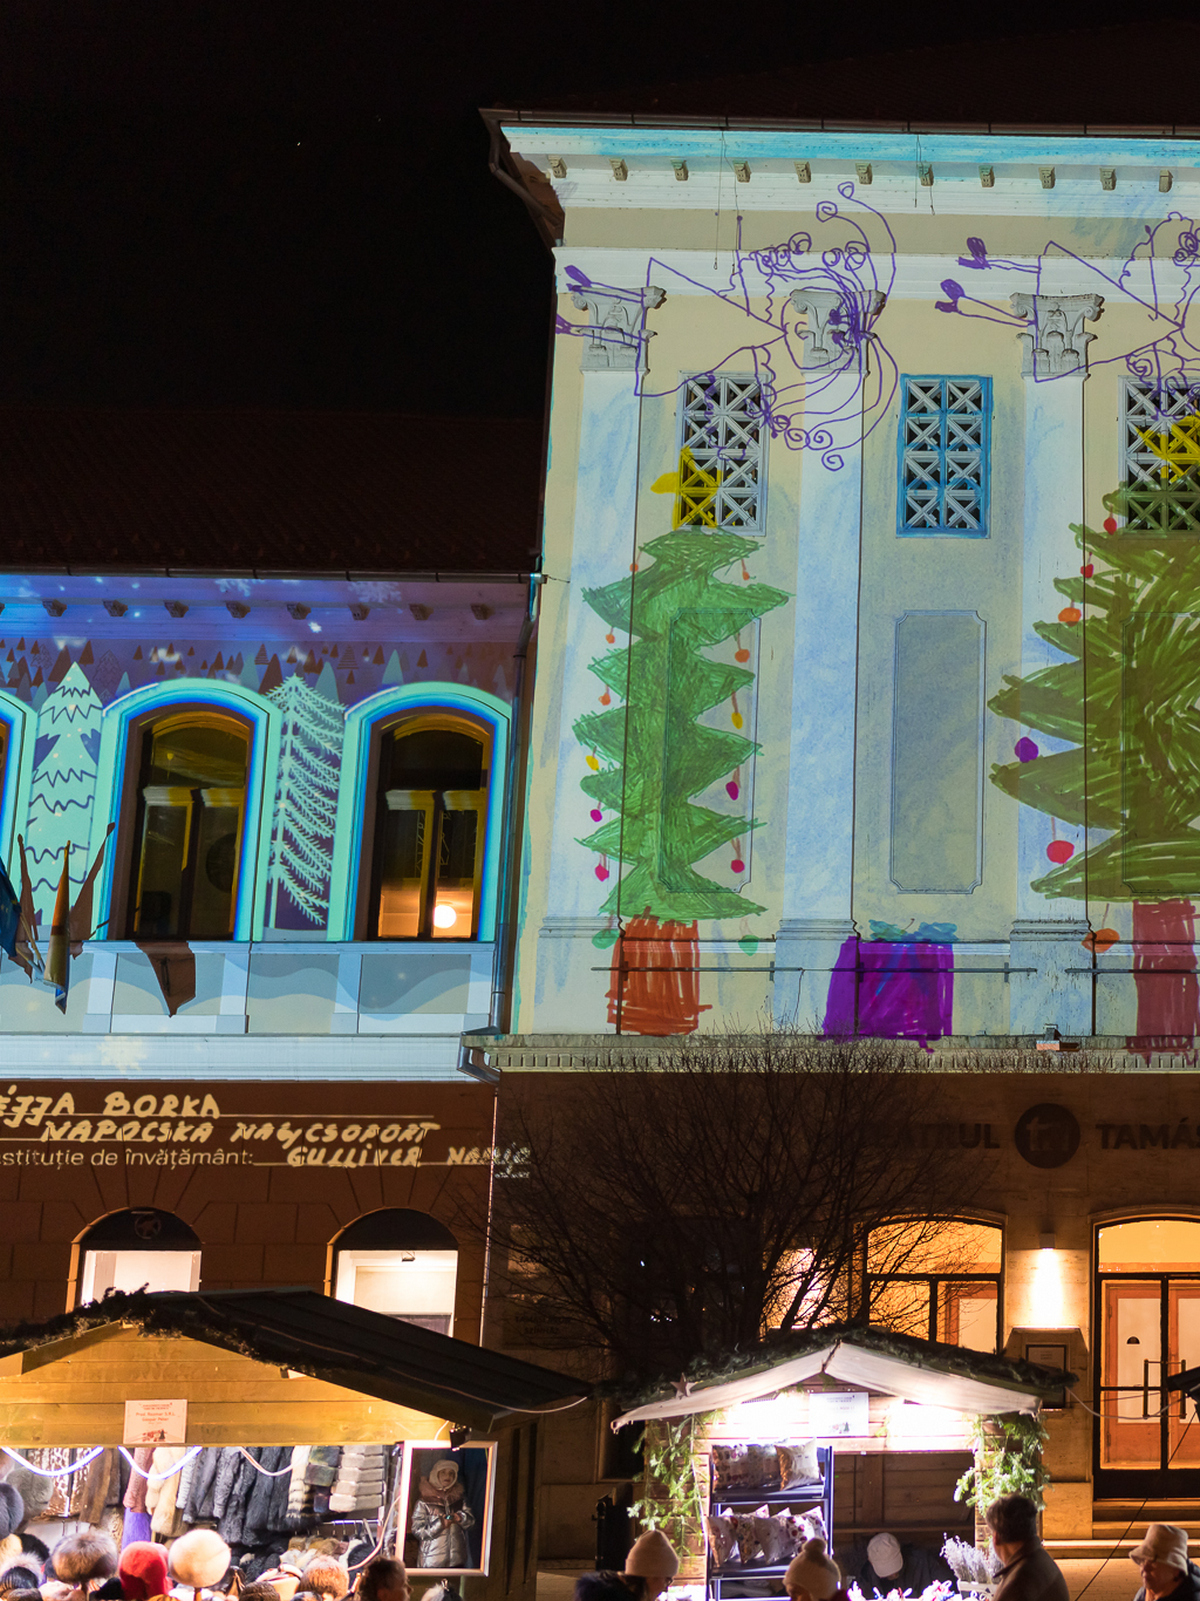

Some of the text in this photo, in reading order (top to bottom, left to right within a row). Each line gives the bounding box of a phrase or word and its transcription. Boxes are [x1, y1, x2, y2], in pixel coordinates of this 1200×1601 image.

[0, 1084, 221, 1129] ÉJJA BORKA
[40, 1119, 215, 1143] NAPOCSKA
[0, 1148, 84, 1170] stituție
[90, 1148, 118, 1166] de
[124, 1147, 254, 1170] învățământ:
